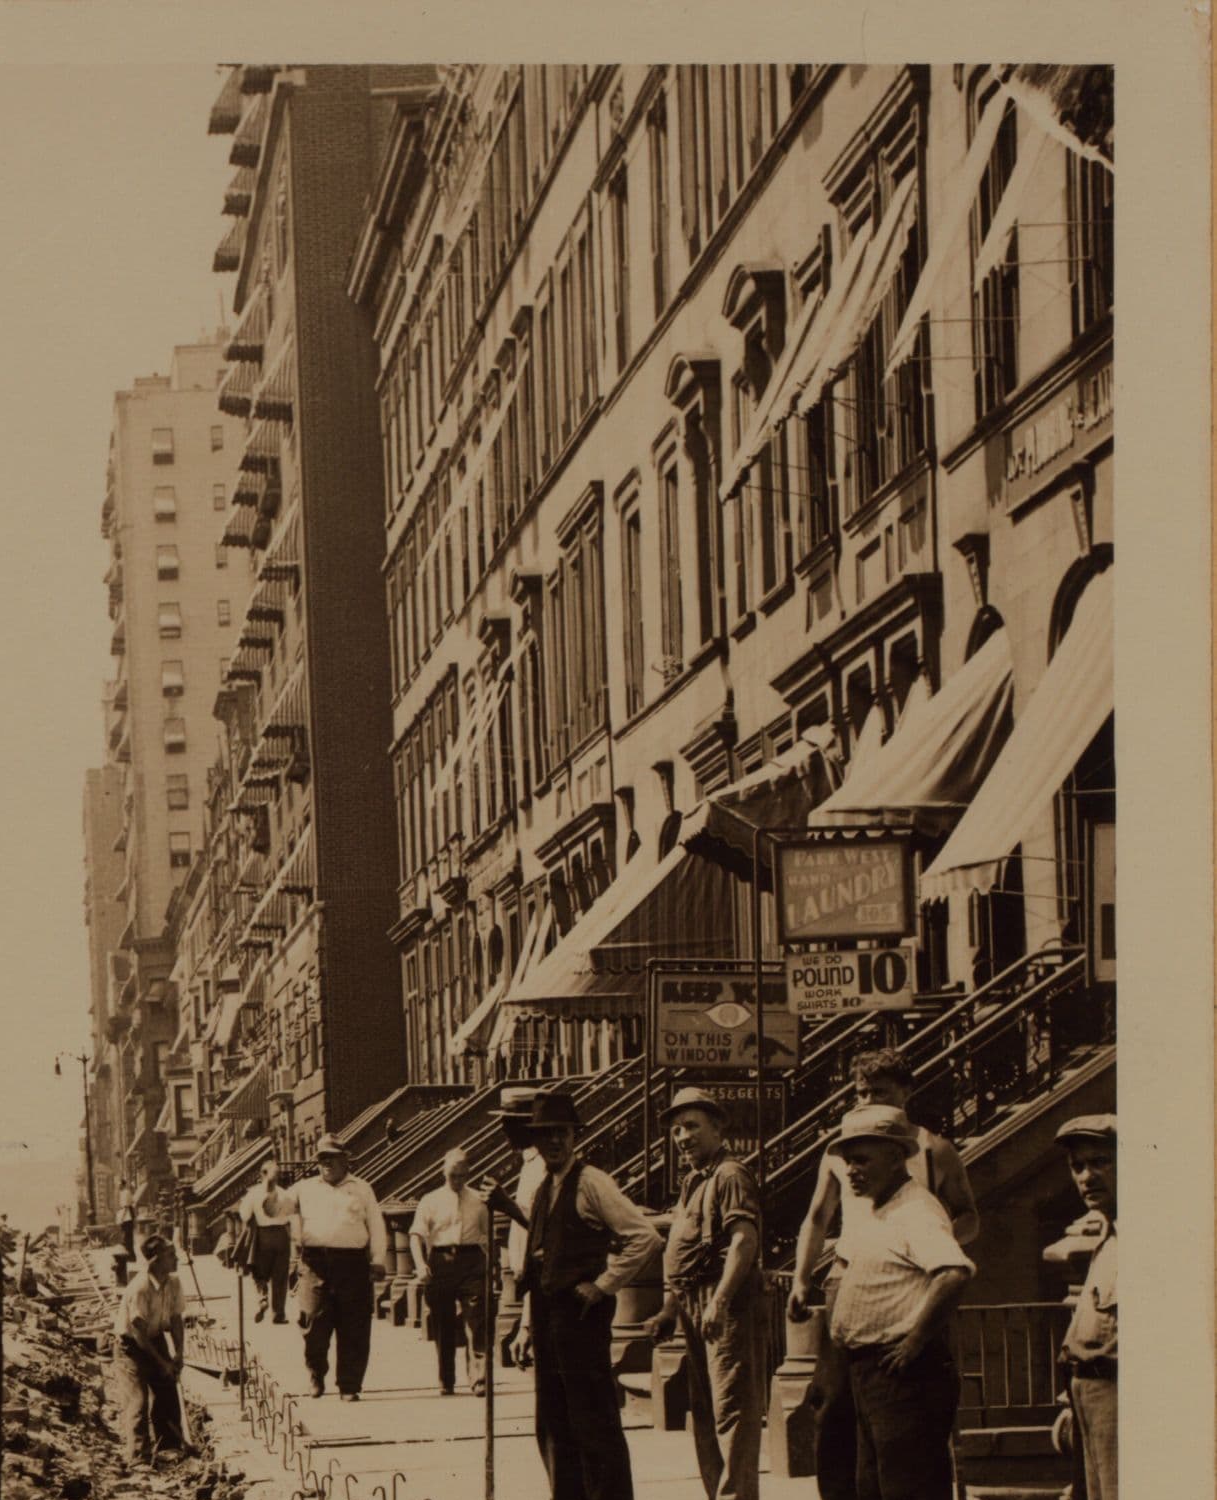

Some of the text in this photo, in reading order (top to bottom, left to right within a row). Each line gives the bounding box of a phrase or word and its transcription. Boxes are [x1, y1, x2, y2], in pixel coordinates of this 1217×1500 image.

[794, 850, 839, 867] PARK
[787, 862, 896, 930] LAUNDRY
[802, 955, 842, 966] WE DO
[792, 966, 854, 988] POUND
[804, 989, 842, 999] WORK
[797, 999, 837, 1011] SHIRTS
[665, 1032, 732, 1046] ON THIS
[666, 1048, 732, 1062] WINDOW
